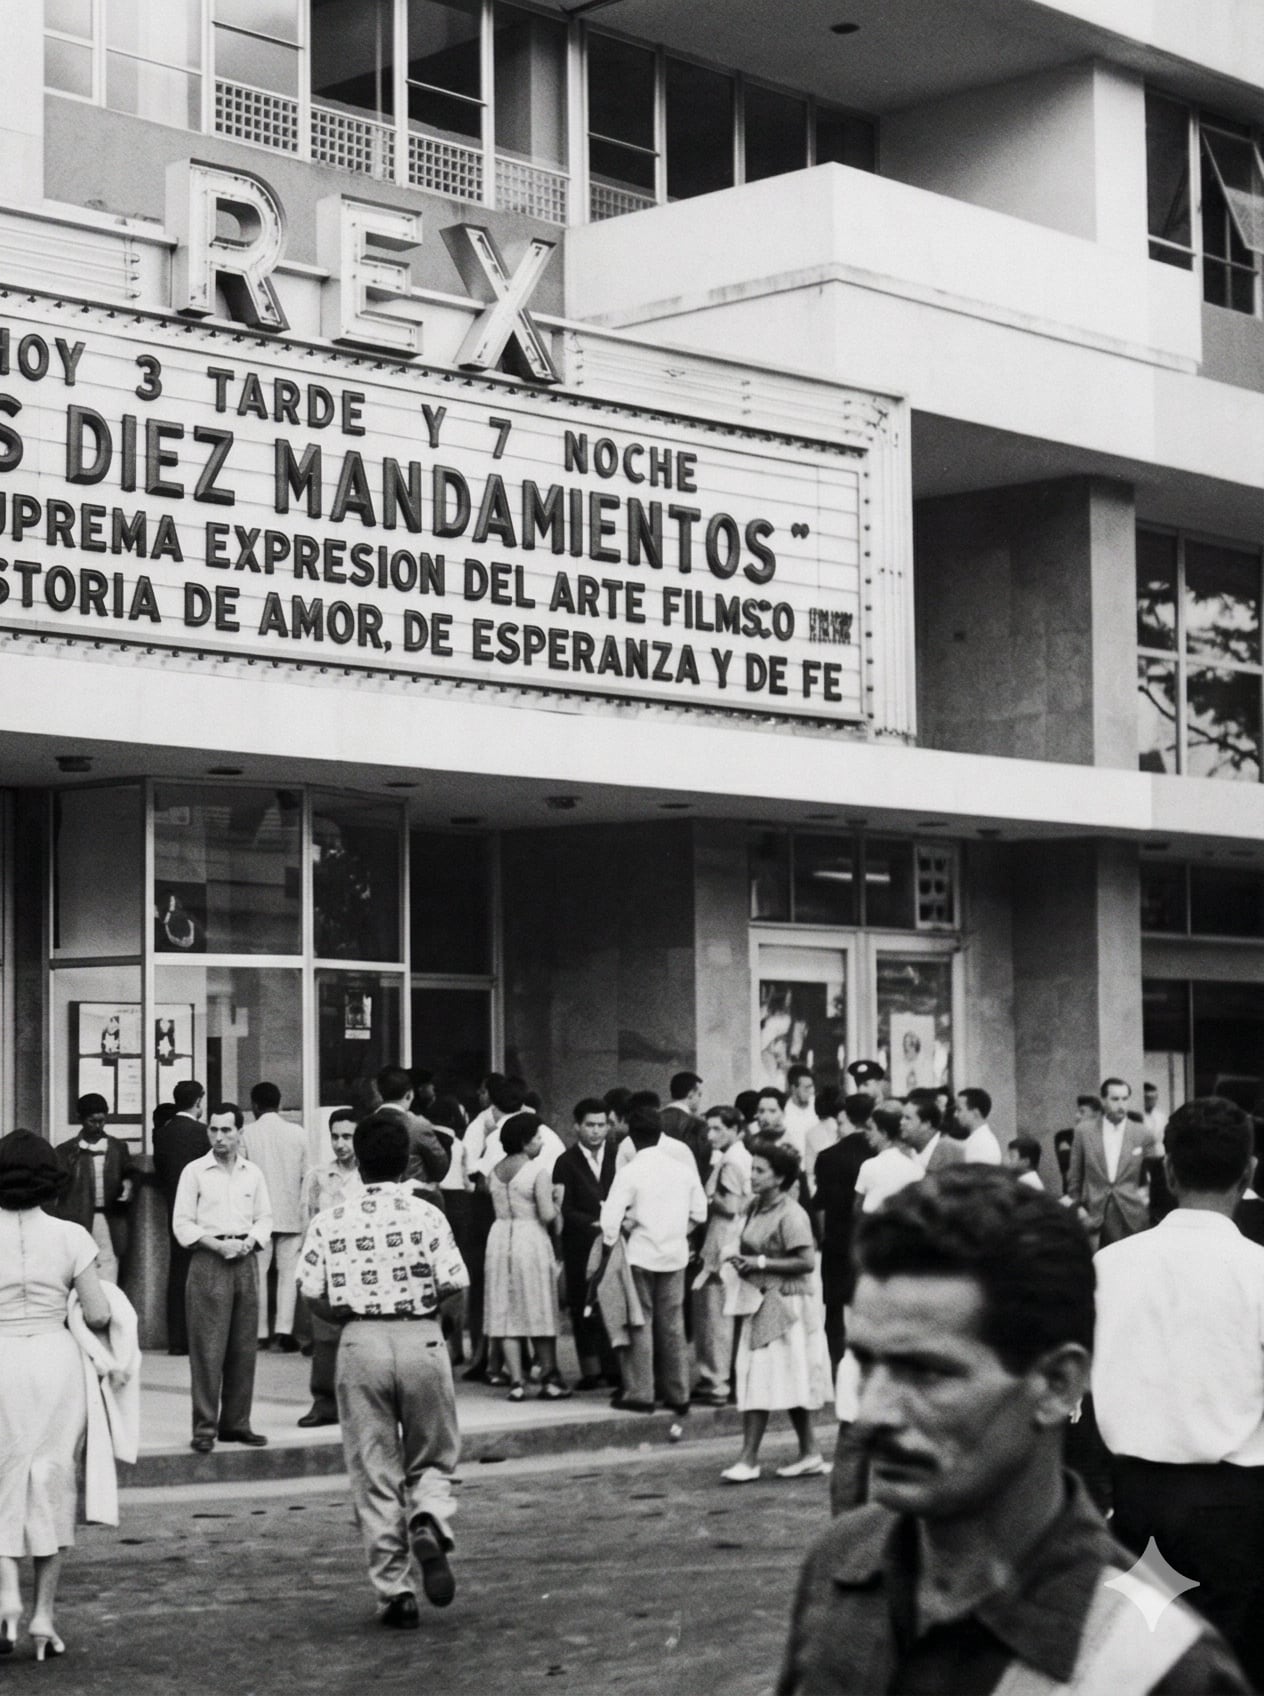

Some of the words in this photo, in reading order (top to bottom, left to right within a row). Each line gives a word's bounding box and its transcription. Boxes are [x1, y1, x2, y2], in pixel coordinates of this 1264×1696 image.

[165, 157, 563, 386] REX
[65, 404, 236, 507] DIEZ
[134, 354, 162, 402] 3
[206, 366, 366, 437] TARDE
[421, 403, 448, 449] Y
[488, 416, 512, 460] 7
[564, 430, 698, 493] NOCHE
[204, 521, 446, 597] EXPRESION
[463, 558, 536, 609] DEL
[549, 571, 646, 624] ARTE
[183, 581, 241, 633] DE
[258, 591, 392, 652] AMOR,
[403, 609, 453, 657] DE
[472, 618, 700, 685] ESPERANZA
[710, 647, 734, 689] Y
[745, 652, 788, 696] DE
[801, 659, 843, 702] FE
